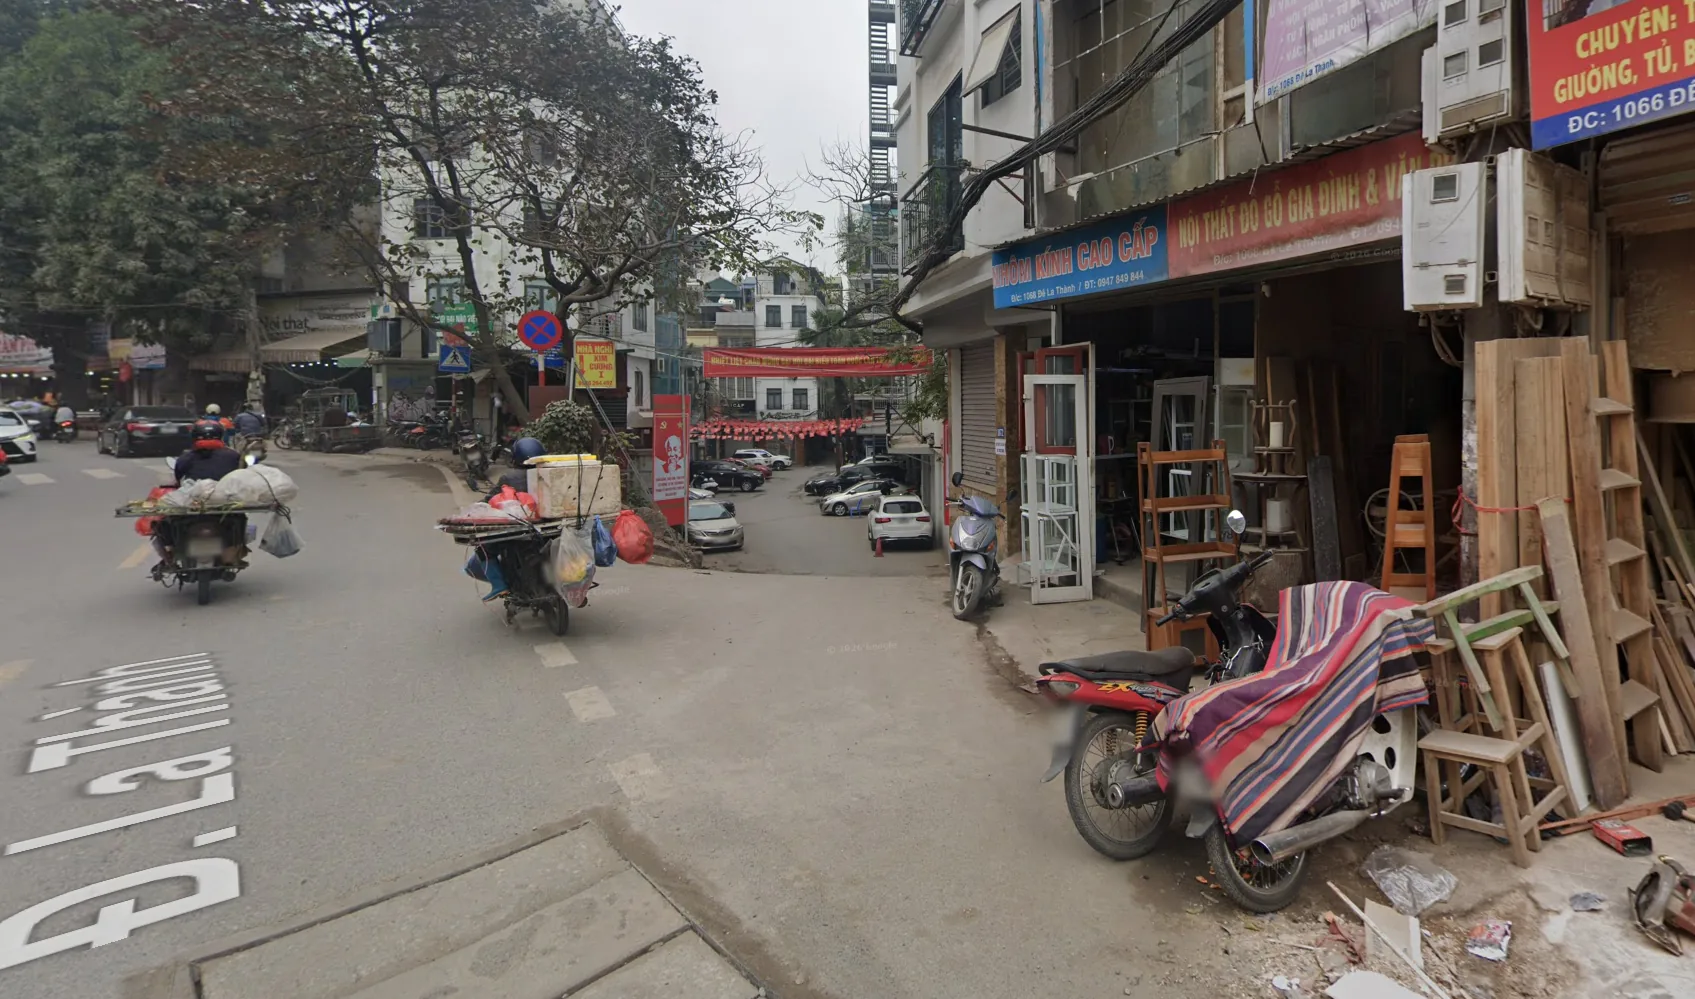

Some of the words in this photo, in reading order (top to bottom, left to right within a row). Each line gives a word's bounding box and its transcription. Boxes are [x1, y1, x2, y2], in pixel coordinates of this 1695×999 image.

[1576, 7, 1677, 58] CHUYÊN:
[1554, 58, 1638, 104] GIƯỜNG,
[1644, 38, 1678, 77] TỦ,
[1567, 111, 1607, 133] ĐC:
[1612, 93, 1664, 121] 1066
[1179, 210, 1199, 253] NỘI
[1203, 195, 1235, 242] THẤT
[1287, 184, 1314, 223] GIA
[1318, 170, 1360, 216] ĐÌNH
[1366, 168, 1379, 205] &
[992, 254, 1032, 289] NHÔM
[1035, 246, 1073, 280] KÍNH
[1077, 237, 1113, 271] CAO
[1118, 216, 1158, 262] CẤP
[1047, 287, 1055, 297] La
[1056, 284, 1076, 295] Thành
[1116, 274, 1128, 284] 849
[1130, 270, 1144, 281] 844
